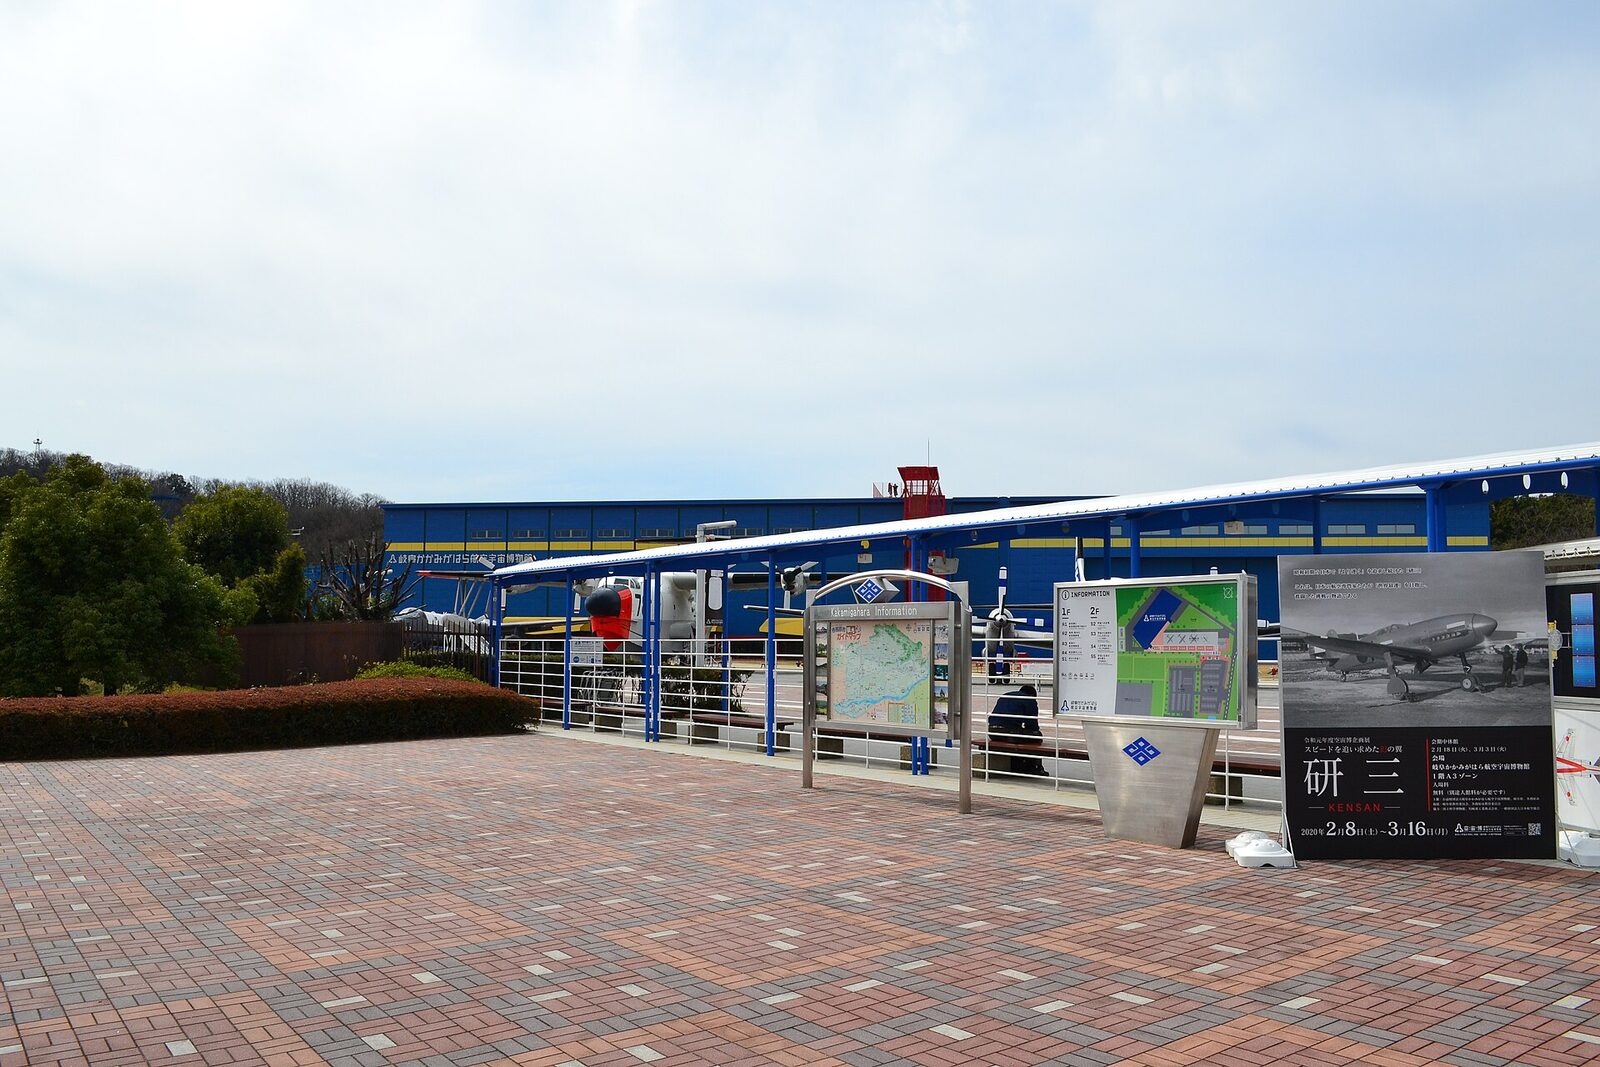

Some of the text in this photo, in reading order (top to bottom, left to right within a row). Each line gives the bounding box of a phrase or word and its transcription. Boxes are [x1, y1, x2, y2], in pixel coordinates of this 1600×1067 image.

[1071, 590, 1110, 598] INFORMATION
[875, 606, 917, 616] Information
[1062, 606, 1100, 616] 1F 2F
[1432, 754, 1445, 762] 会場
[1328, 803, 1382, 812] KENSAN
